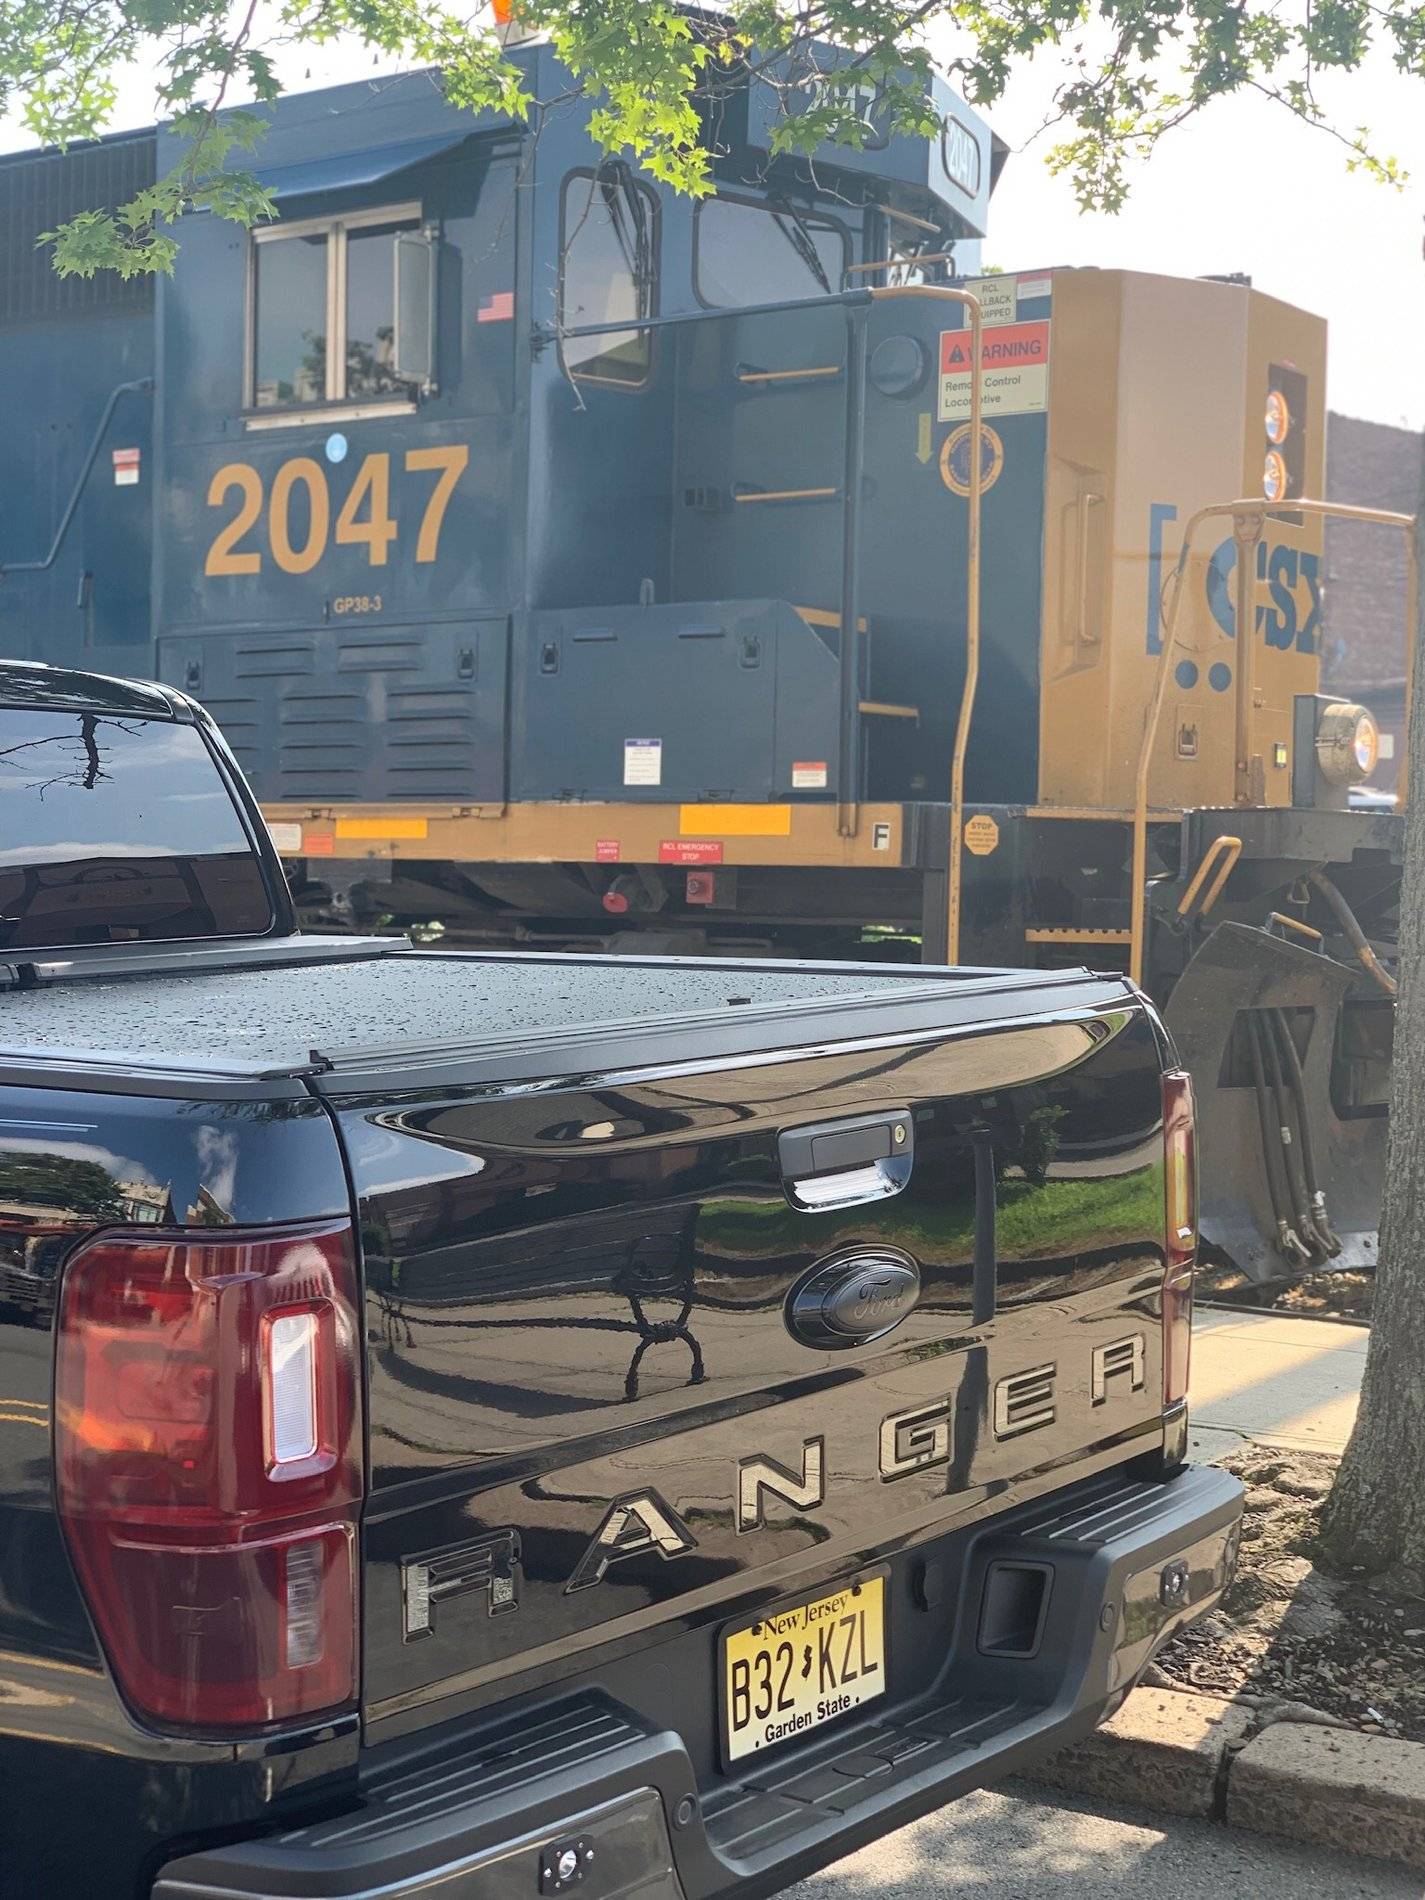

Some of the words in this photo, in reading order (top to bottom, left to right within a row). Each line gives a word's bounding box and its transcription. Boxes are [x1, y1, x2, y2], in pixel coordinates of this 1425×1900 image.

[984, 375, 1021, 388] Control
[205, 444, 469, 577] 2047
[333, 595, 382, 613] GP38-3
[678, 843, 719, 852] EMERGENCY
[681, 852, 700, 861] STOP
[873, 824, 889, 848] F
[854, 1277, 906, 1320] Ford
[402, 1332, 1146, 1645] RANGER
[763, 1613, 800, 1641] New
[801, 1594, 849, 1631] Jersey
[732, 1641, 795, 1732] B32
[818, 1610, 878, 1694] KZL
[765, 1711, 812, 1744] Garden
[817, 1694, 851, 1721] State
